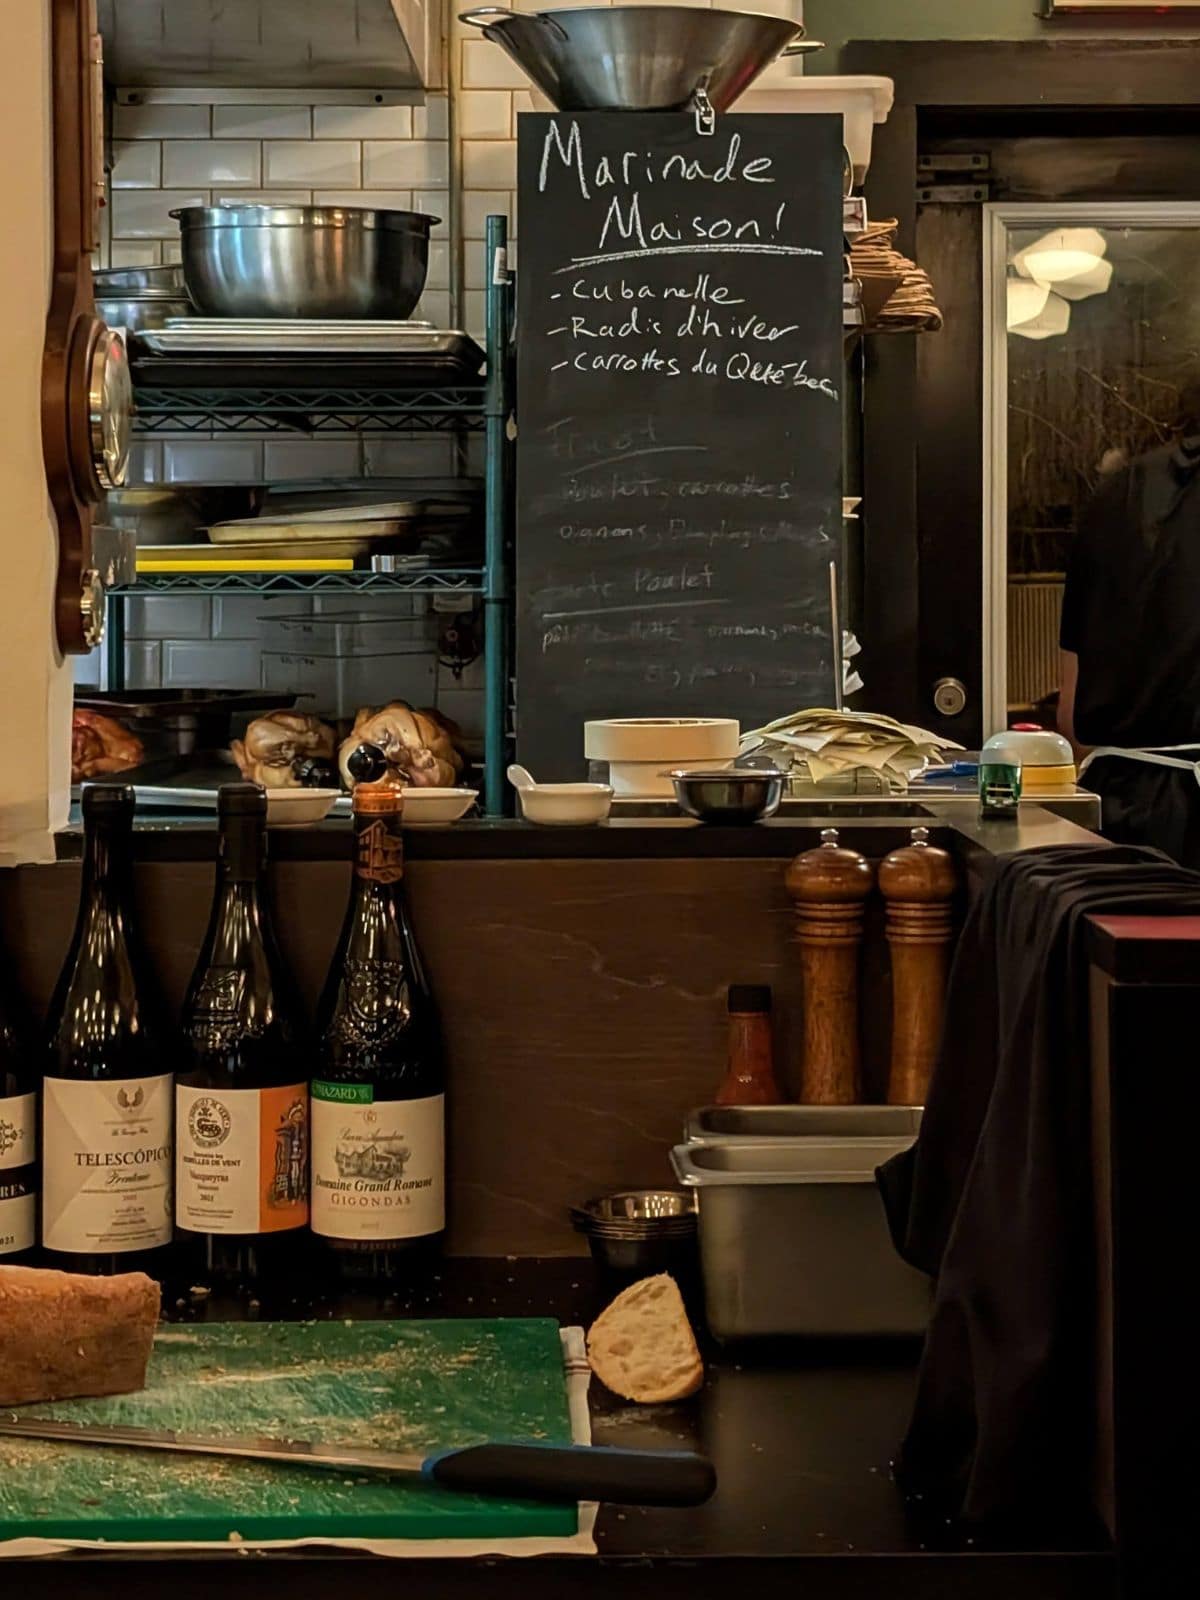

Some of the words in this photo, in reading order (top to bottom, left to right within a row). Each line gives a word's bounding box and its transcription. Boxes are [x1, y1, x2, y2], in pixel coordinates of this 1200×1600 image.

[540, 119, 775, 198] Marinade
[599, 192, 785, 248] Maison!
[677, 305, 799, 340] d'hiver
[692, 357, 717, 375] du
[222, 1159, 241, 1167] VENT
[354, 1178, 390, 1193] Grand
[331, 1193, 411, 1207] GIGONDAS
